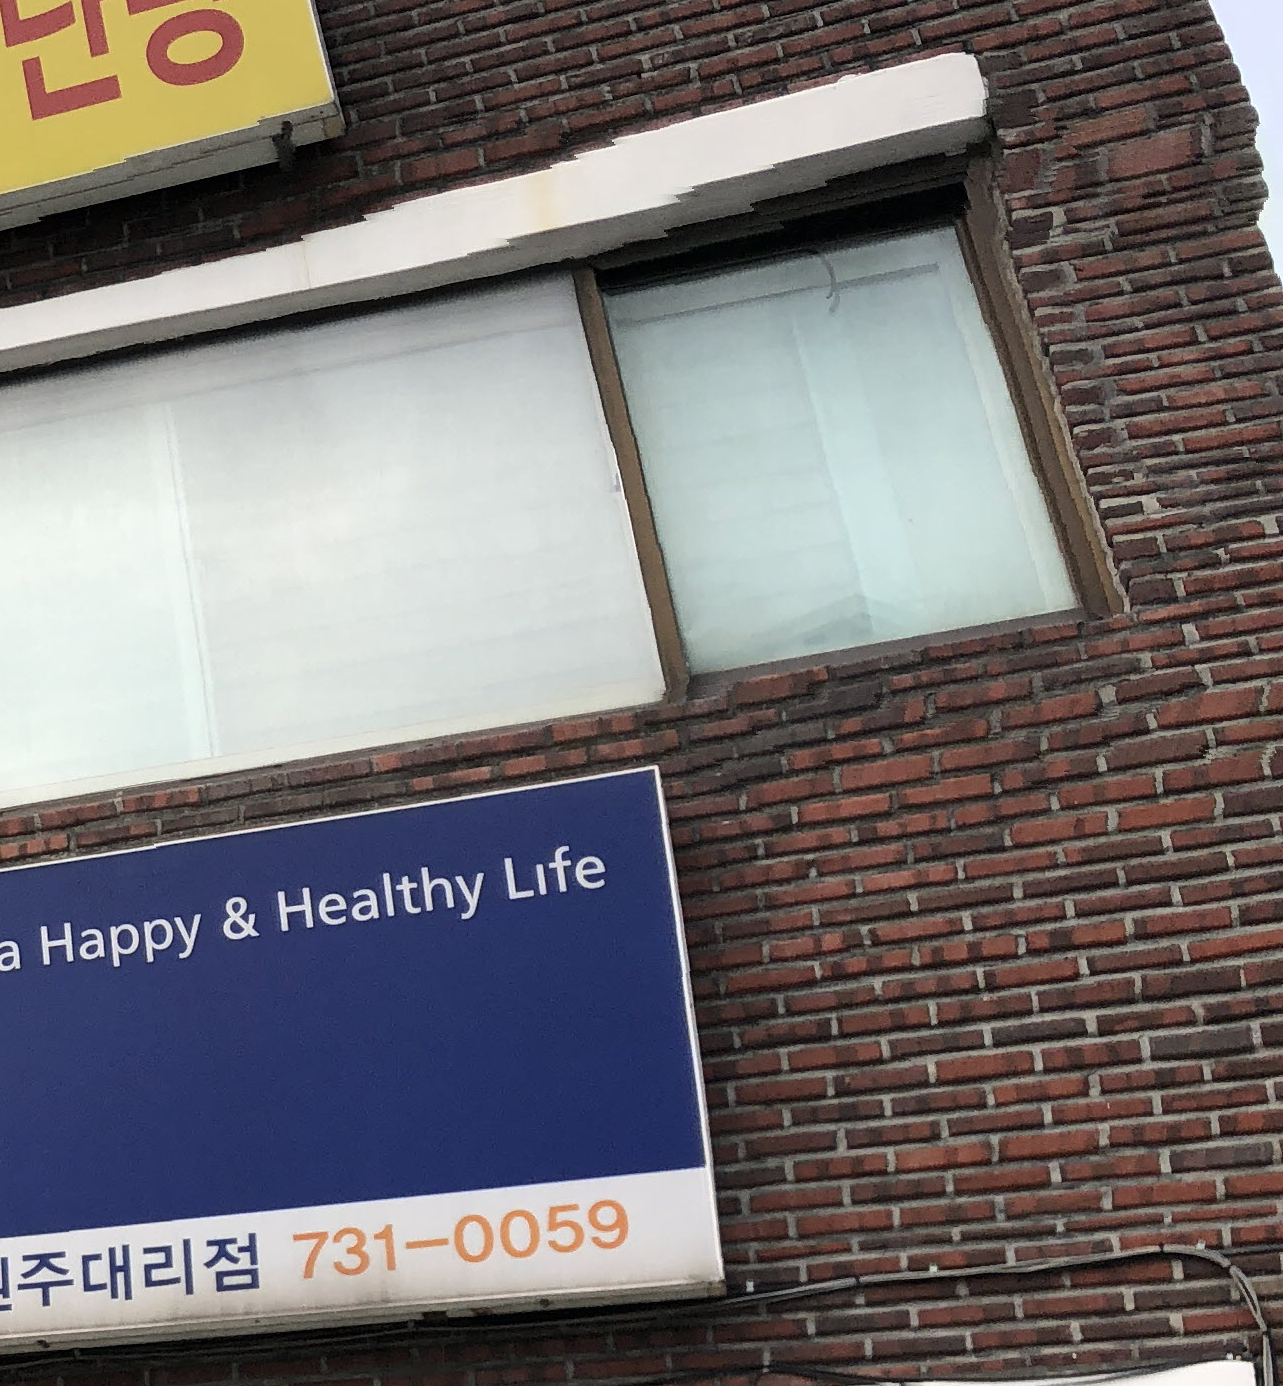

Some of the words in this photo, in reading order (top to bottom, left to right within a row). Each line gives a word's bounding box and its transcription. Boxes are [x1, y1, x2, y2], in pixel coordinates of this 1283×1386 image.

[41, 914, 202, 968] Happy
[222, 895, 260, 939] &
[277, 866, 484, 932] Healthy
[505, 847, 608, 899] Life
[292, 1197, 631, 1282] 731-0059
